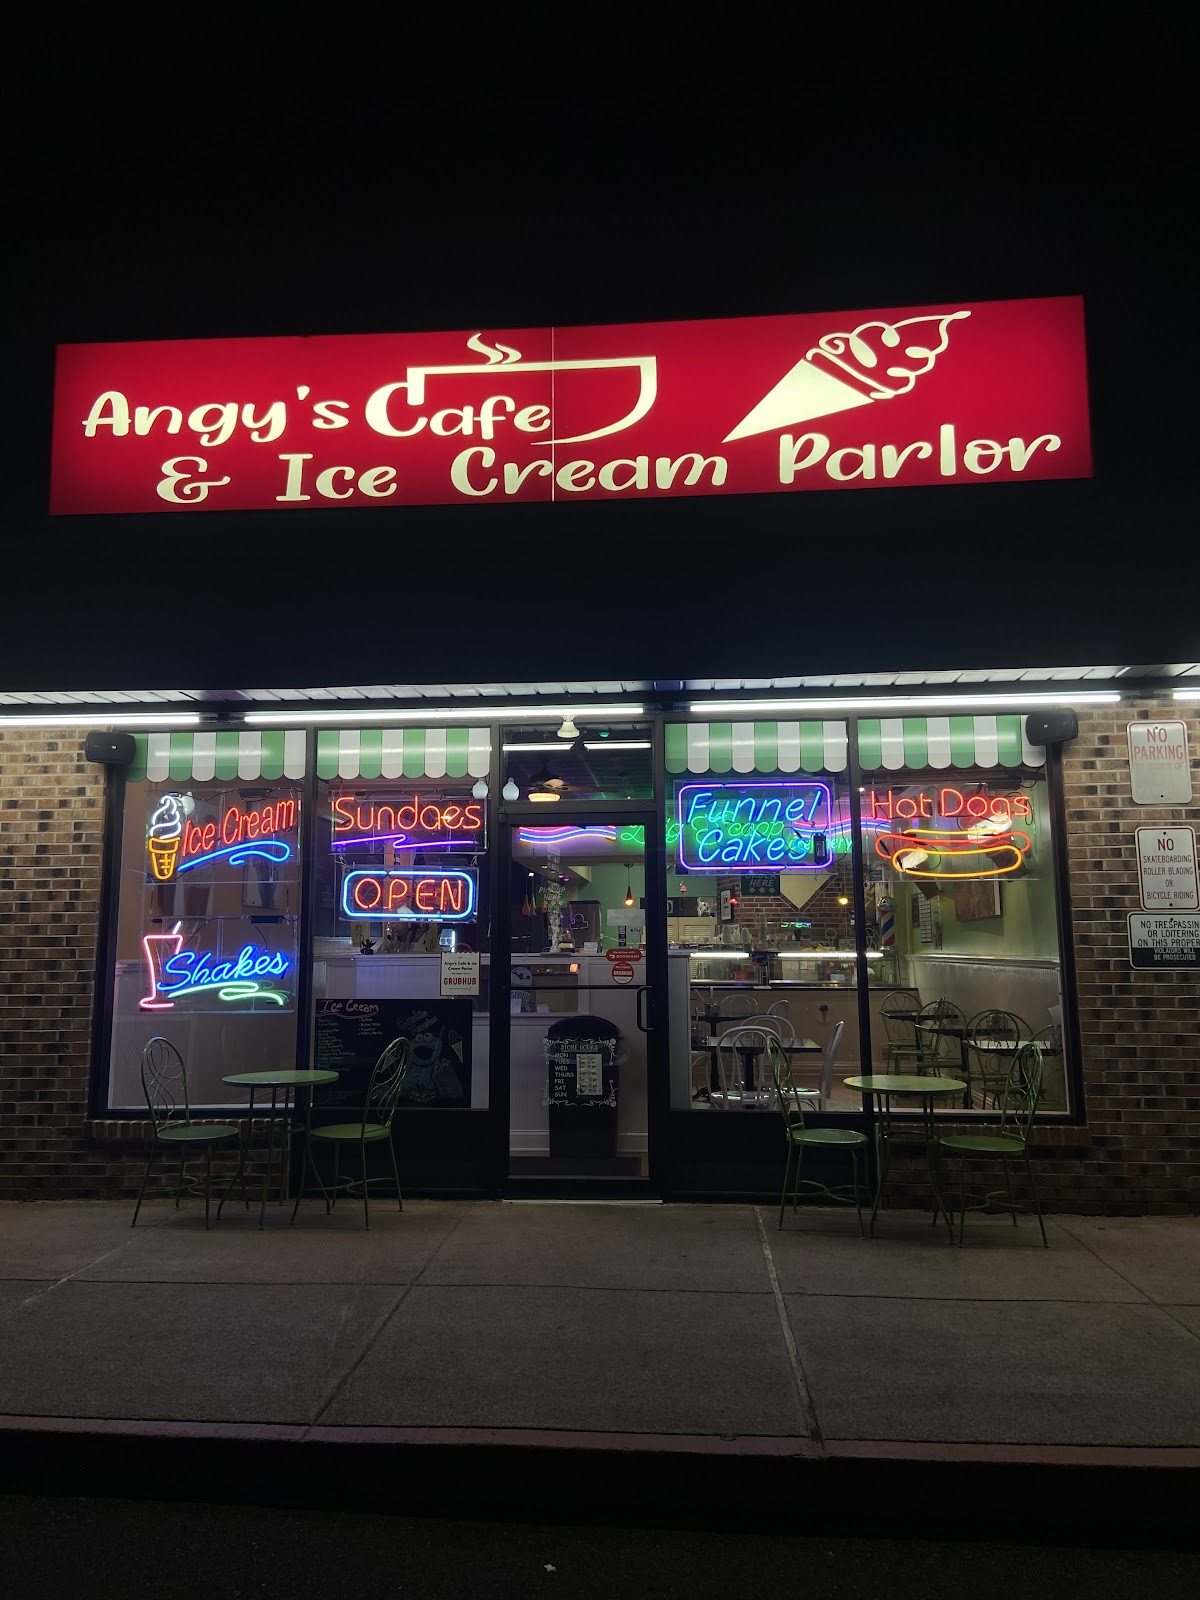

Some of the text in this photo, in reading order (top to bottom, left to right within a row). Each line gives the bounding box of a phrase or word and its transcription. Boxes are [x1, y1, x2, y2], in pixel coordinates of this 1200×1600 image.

[82, 380, 552, 447] Angy's Cafe
[156, 424, 1062, 504] & Ice Cream Parlor
[1146, 728, 1168, 743] NO
[1133, 745, 1184, 761] PARKING
[686, 790, 822, 823] Funnel
[871, 787, 1031, 824] Hot Dogs
[334, 795, 481, 831] Sundaes
[181, 800, 295, 857] Ice Cream
[698, 828, 807, 863] Cakes
[1157, 838, 1175, 851] NO
[1142, 855, 1192, 864] SKATEBOARDING
[1143, 866, 1194, 876] ROLLER BLADING
[749, 879, 775, 887] HERE
[1165, 879, 1174, 888] OR
[354, 878, 462, 911] OPEN
[1146, 891, 1194, 900] BICYCLE RIDING
[1140, 920, 1152, 929] NO
[1147, 929, 1200, 938] OR LOITERING
[1138, 939, 1149, 947] ON
[1152, 939, 1168, 947] THIS
[156, 945, 290, 990] Shakes
[443, 977, 477, 986] GRUBHUB
[320, 999, 380, 1013] Ice Cream
